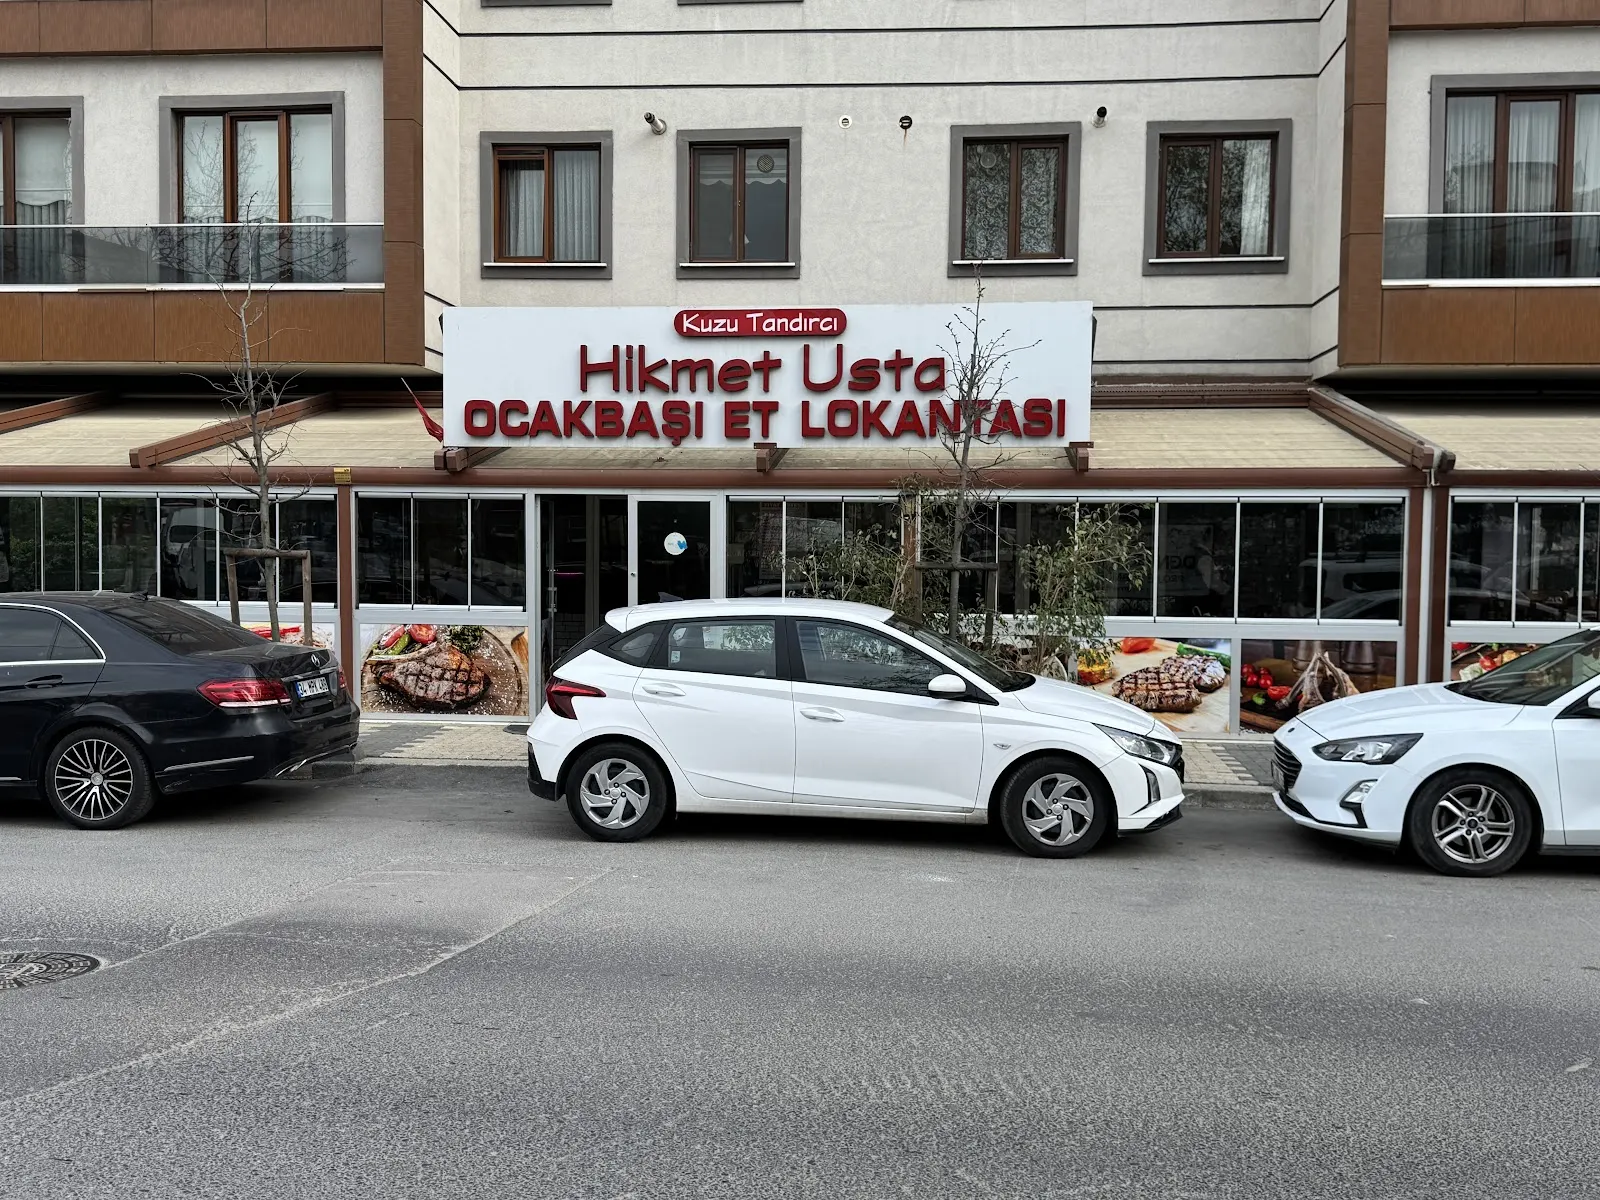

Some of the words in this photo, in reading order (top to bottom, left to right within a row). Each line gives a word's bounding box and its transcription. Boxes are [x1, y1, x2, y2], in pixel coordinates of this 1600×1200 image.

[682, 313, 739, 333] Kuzu
[746, 312, 838, 332] Tandırcı
[579, 344, 782, 392] Hikmet
[803, 343, 946, 392] Usta
[463, 399, 704, 445] OCAKBAŞI
[724, 400, 780, 438] ET
